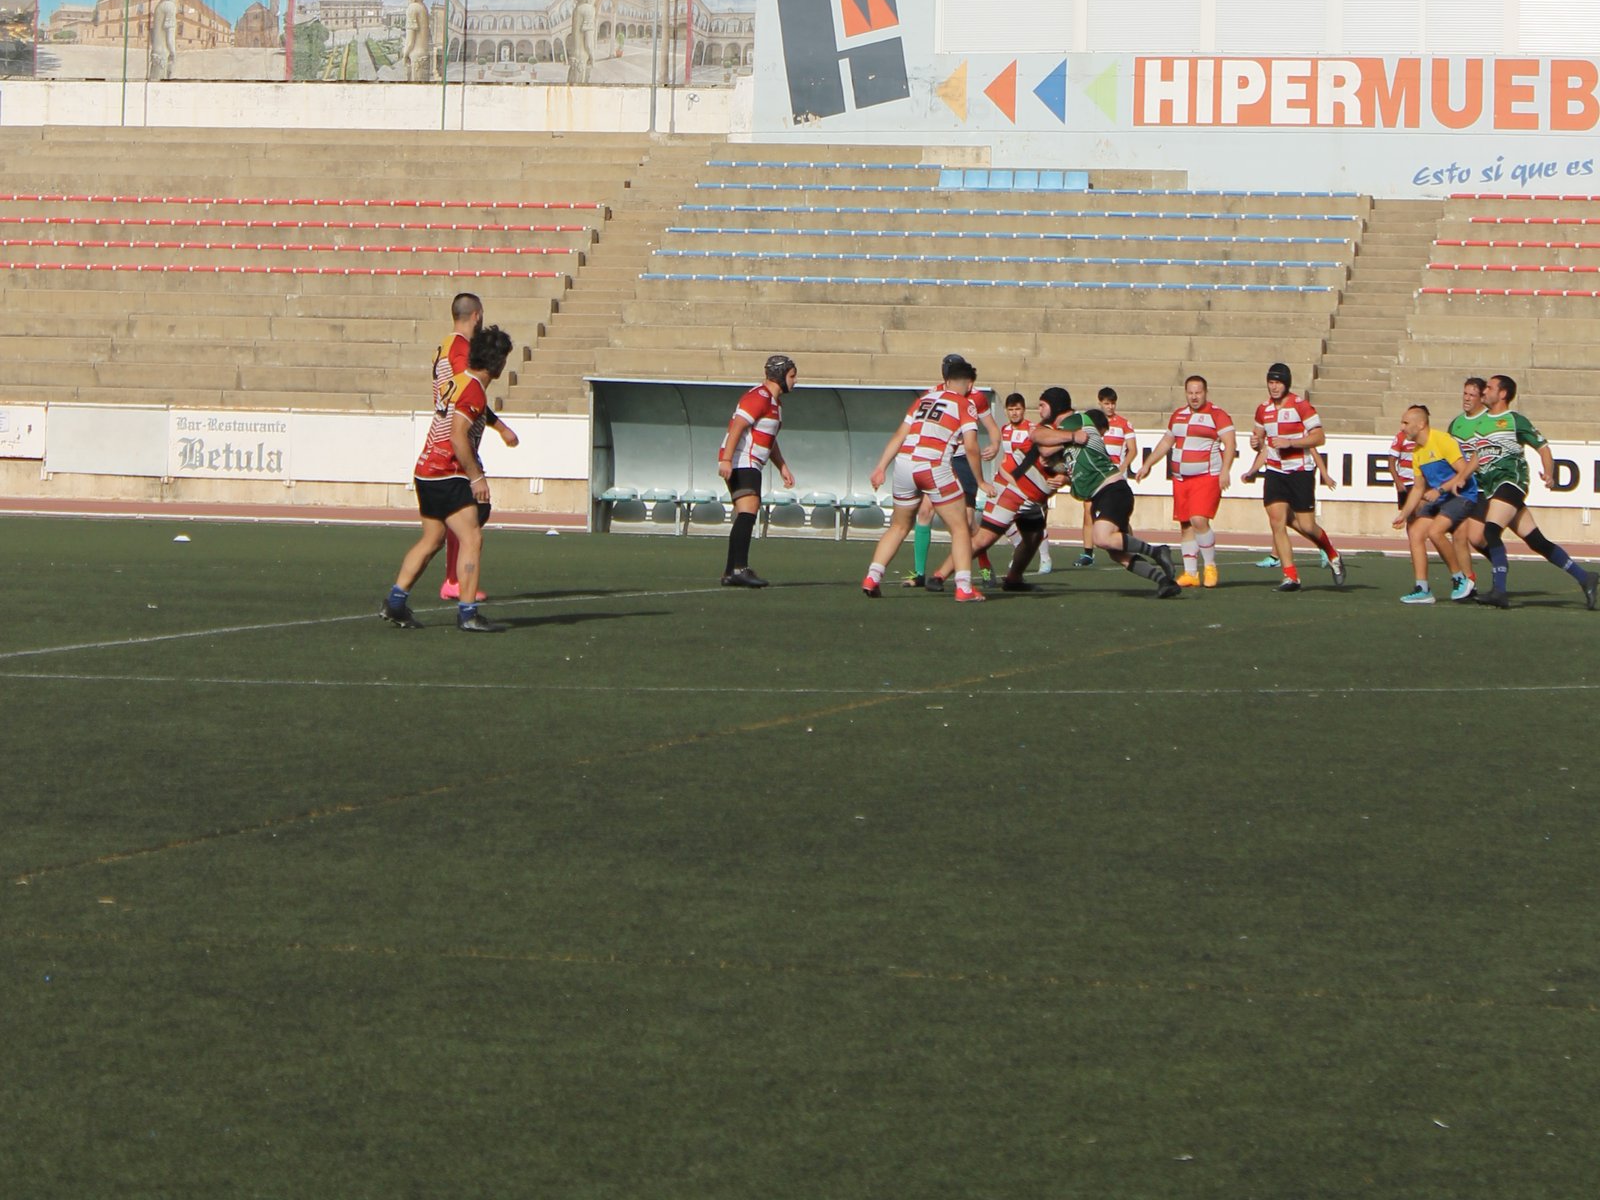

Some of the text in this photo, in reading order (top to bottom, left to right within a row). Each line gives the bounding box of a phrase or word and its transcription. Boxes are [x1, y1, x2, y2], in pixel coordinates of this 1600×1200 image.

[1143, 57, 1600, 130] HIPERMUEB
[1412, 162, 1471, 186] Esto
[1511, 162, 1558, 188] que
[1566, 159, 1594, 176] es
[176, 417, 287, 433] Bar-Restaurante
[915, 401, 948, 422] 56
[177, 437, 283, 473] Betula
